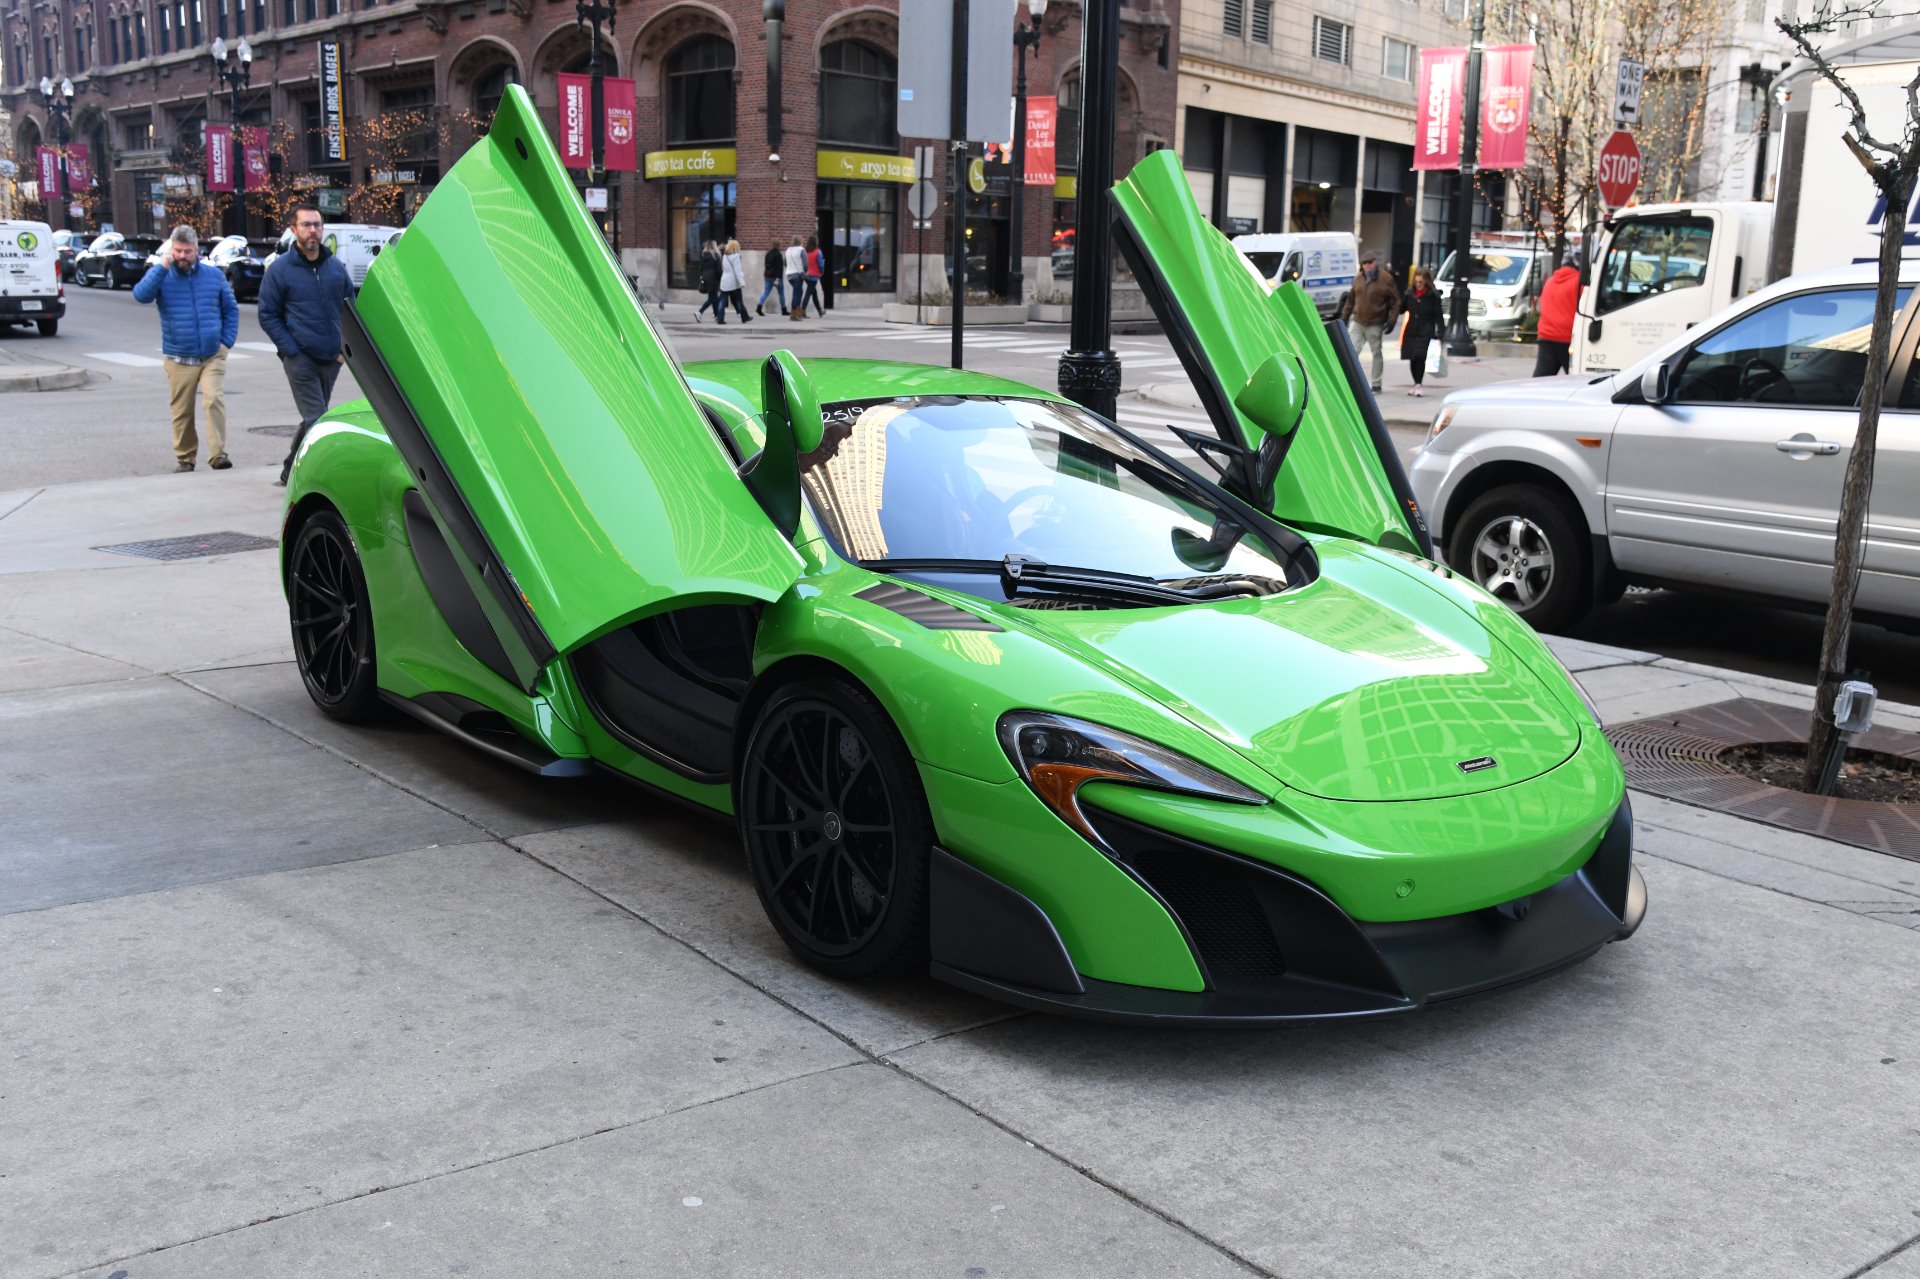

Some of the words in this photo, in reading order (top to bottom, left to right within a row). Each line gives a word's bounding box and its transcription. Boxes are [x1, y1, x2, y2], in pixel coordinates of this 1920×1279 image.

[324, 43, 338, 82] BAGELS
[1621, 65, 1641, 82] ONE
[1620, 82, 1639, 98] WAY
[567, 85, 579, 157] WELCOME
[608, 108, 631, 116] LOYOLA
[1425, 63, 1443, 155] WELCOME
[328, 113, 341, 159] EINSTEIN
[212, 133, 222, 183] WELCOME
[670, 157, 684, 171] tea
[687, 150, 715, 170] café
[860, 161, 886, 179] argo
[888, 161, 900, 177] tea
[1601, 153, 1638, 185] STOP
[42, 152, 51, 192] WELCOME
[1587, 354, 1607, 364] 432
[1464, 758, 1491, 769] McLaren
